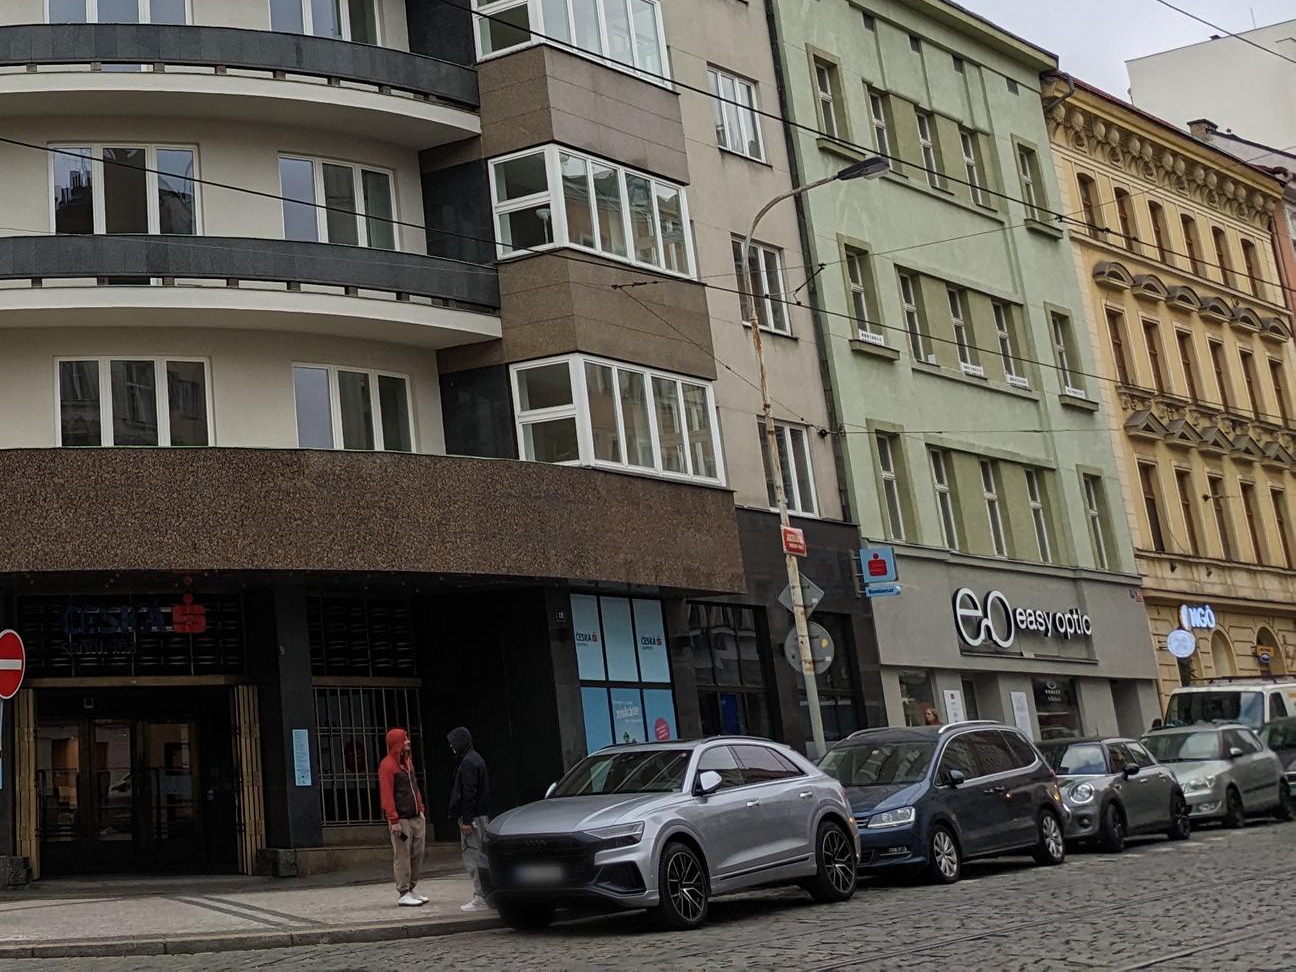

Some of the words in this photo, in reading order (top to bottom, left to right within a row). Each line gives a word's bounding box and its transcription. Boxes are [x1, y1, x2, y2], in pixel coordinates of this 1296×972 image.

[1015, 607, 1052, 637] easy
[1055, 608, 1092, 639] optic
[576, 632, 592, 642] ČESKÁ
[641, 636, 656, 646] ČESKÁ
